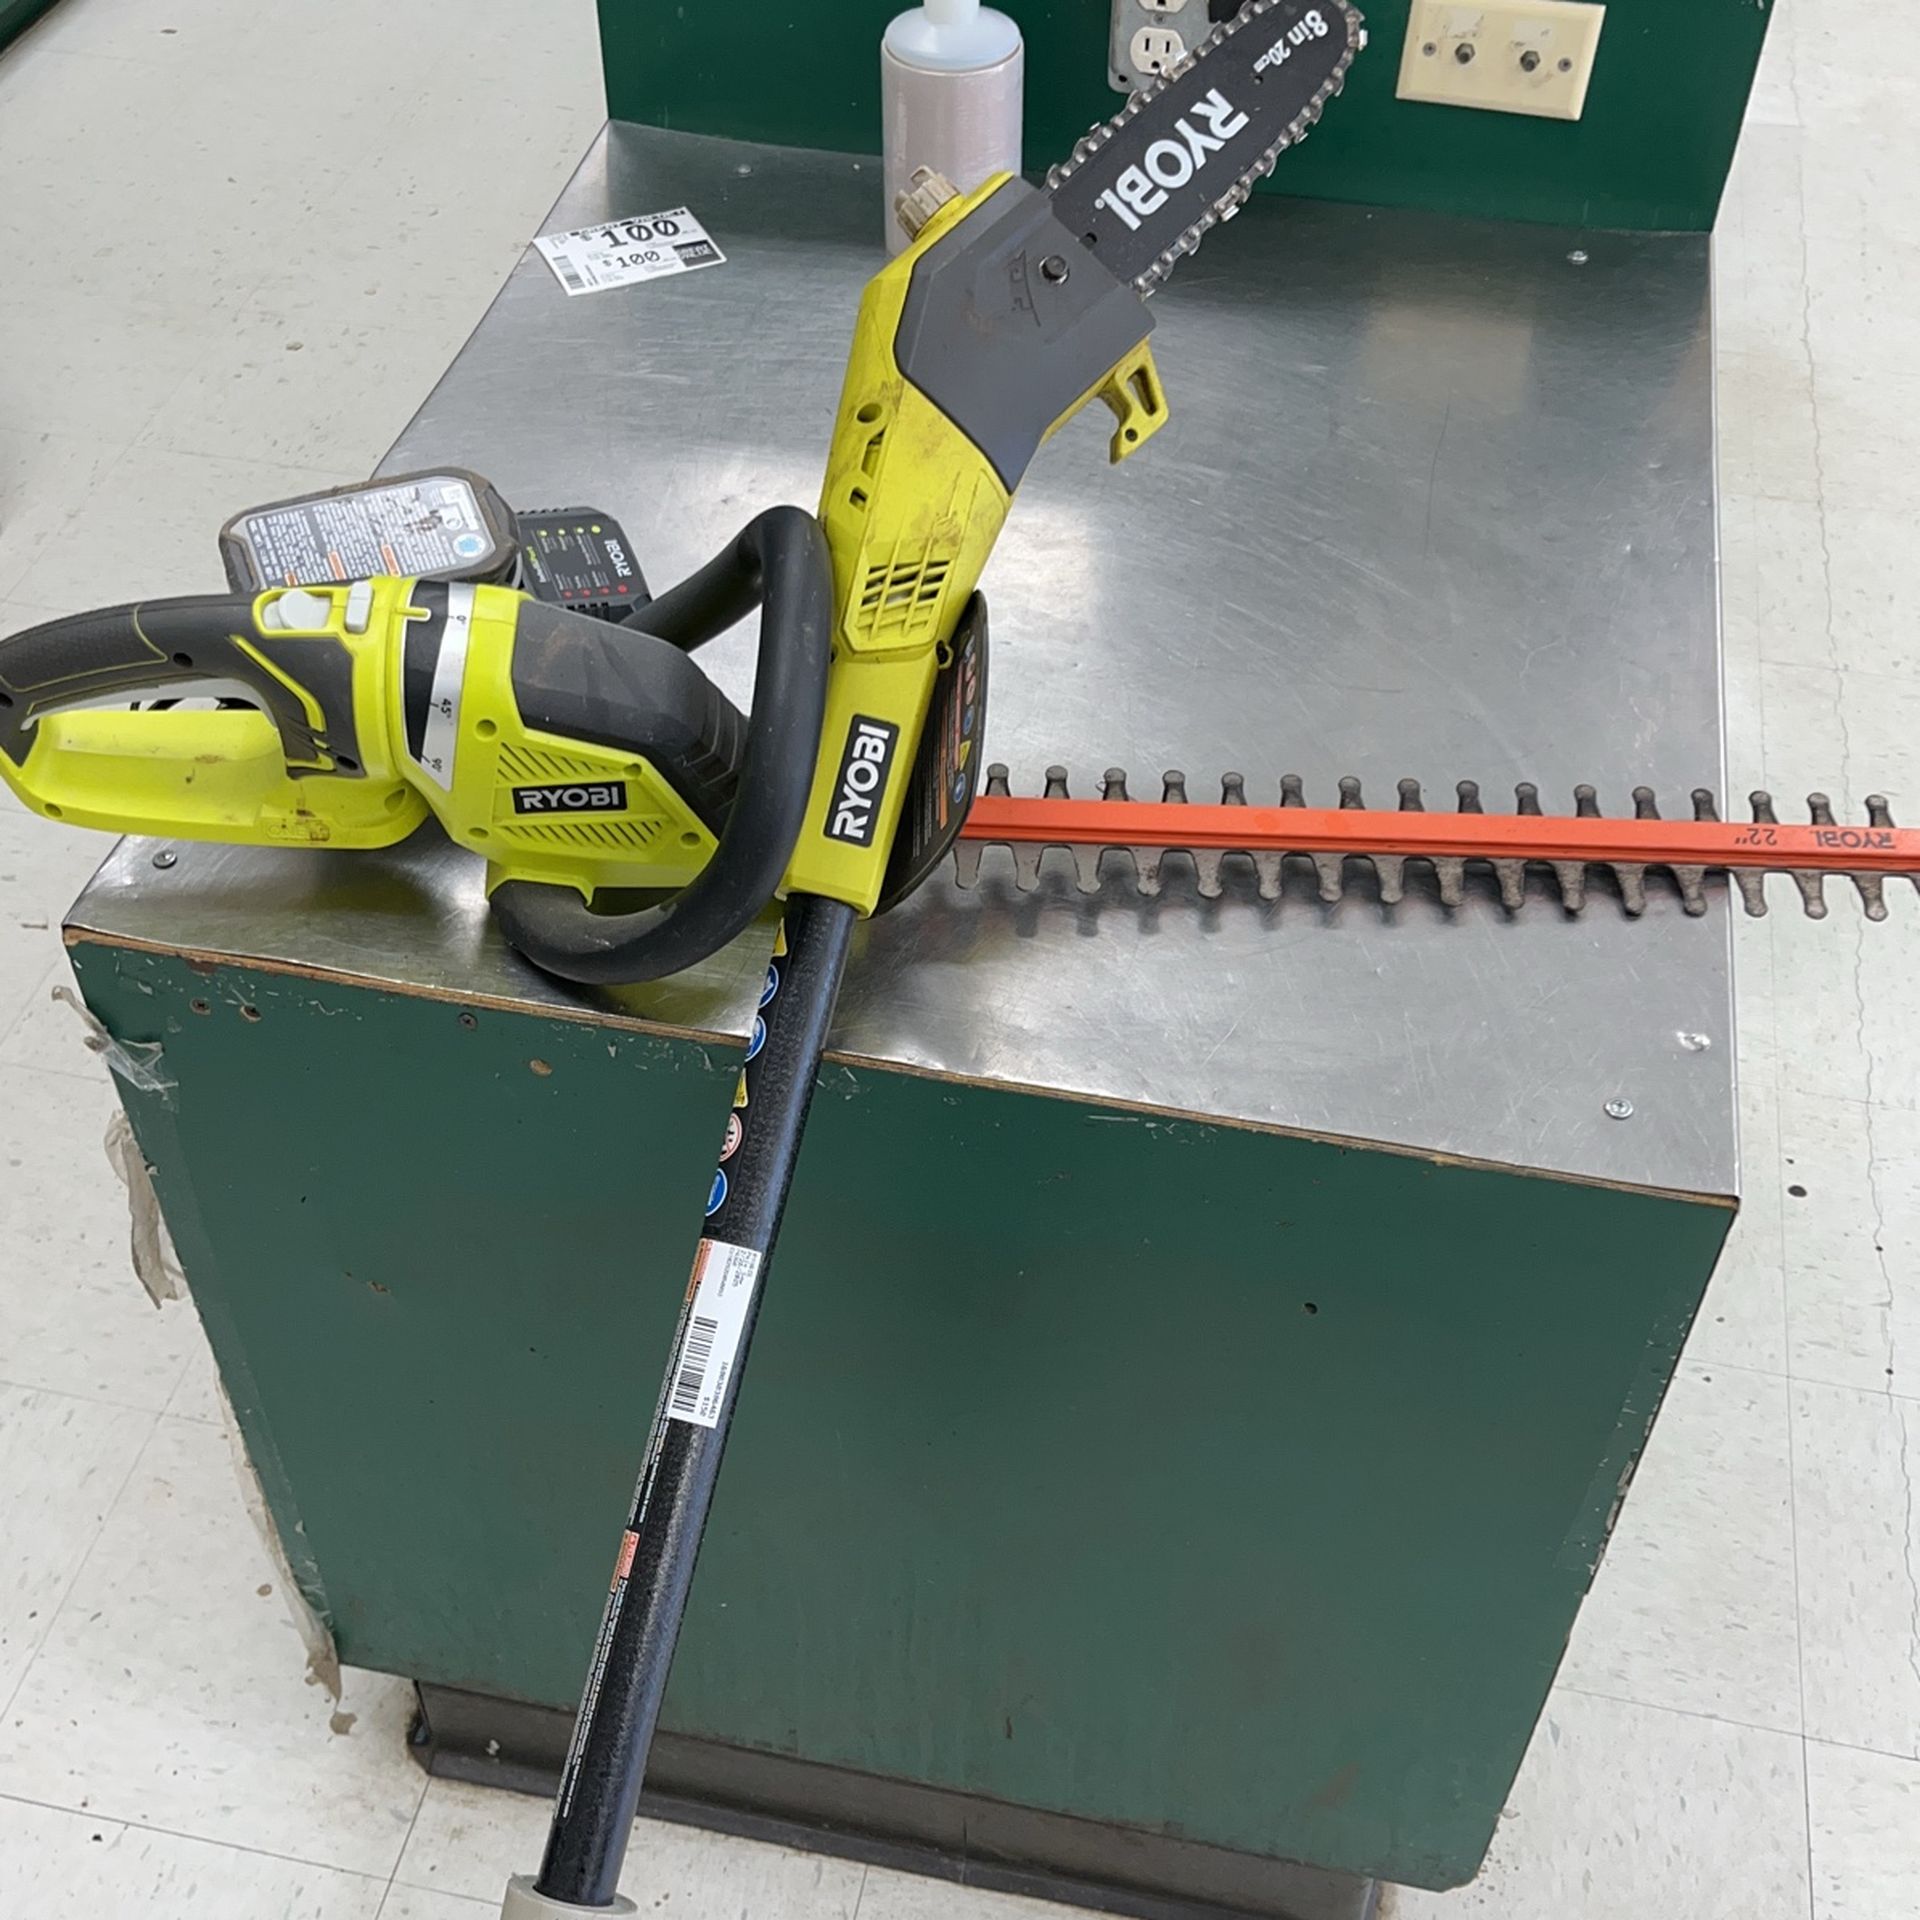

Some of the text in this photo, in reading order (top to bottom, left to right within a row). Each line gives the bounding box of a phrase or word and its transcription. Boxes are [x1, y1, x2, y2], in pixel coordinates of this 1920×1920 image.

[1099, 87, 1250, 232] RYOBI
[600, 219, 681, 248] 100
[616, 250, 661, 268] 100
[604, 538, 633, 578] RYOBI
[832, 723, 891, 840] RYOBI
[519, 785, 620, 811] RYOBI
[1814, 830, 1896, 849] RYOBI
